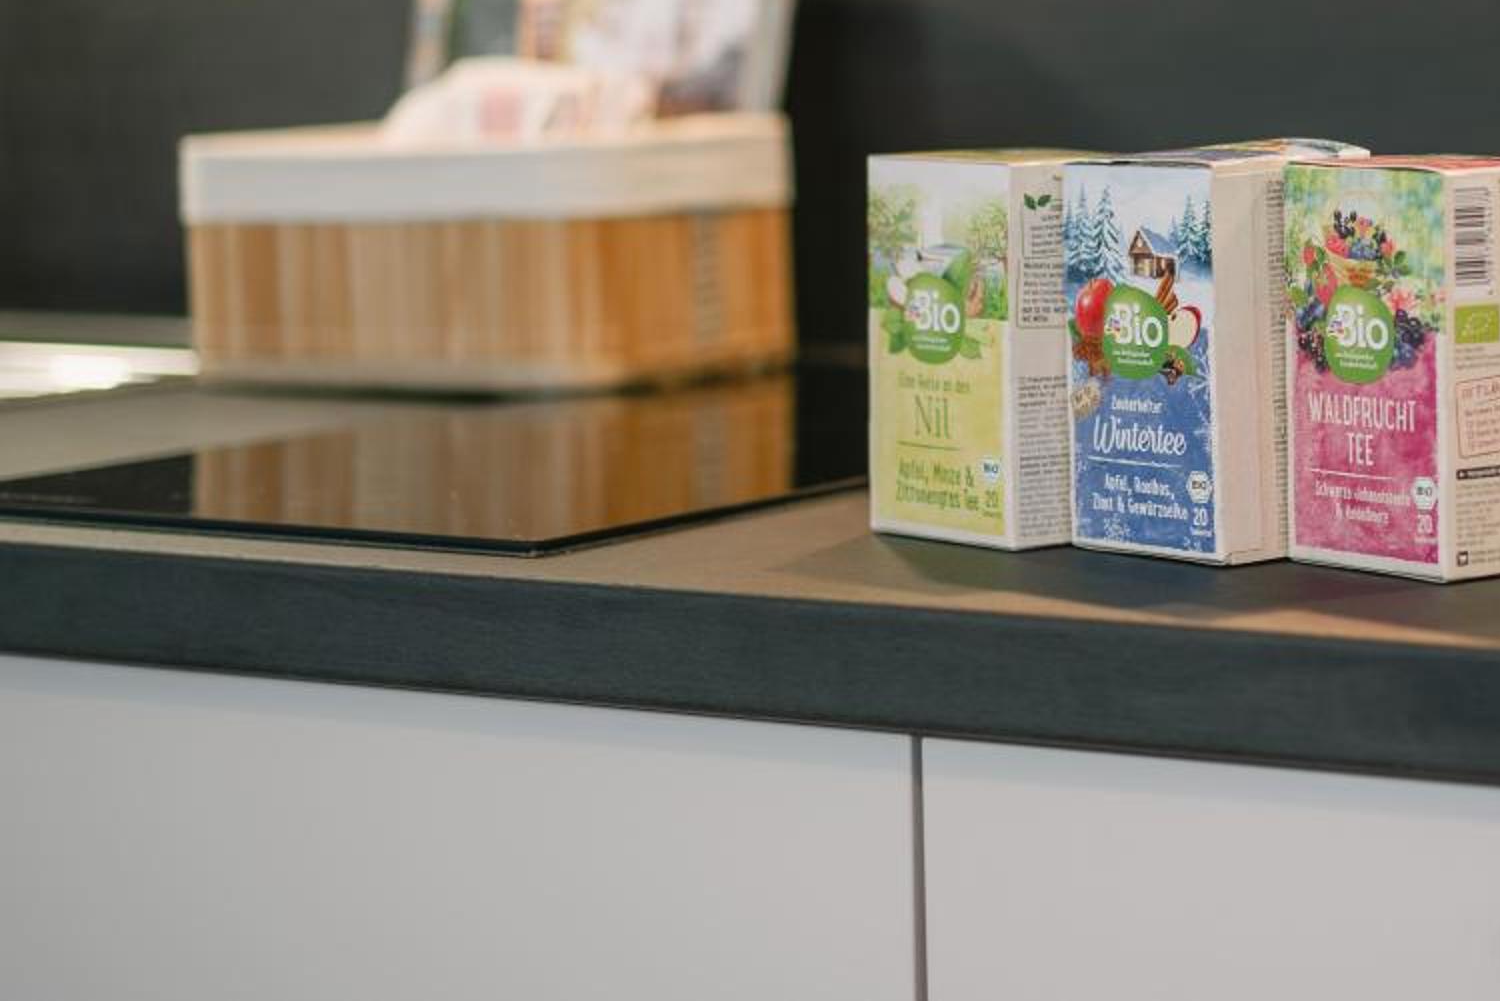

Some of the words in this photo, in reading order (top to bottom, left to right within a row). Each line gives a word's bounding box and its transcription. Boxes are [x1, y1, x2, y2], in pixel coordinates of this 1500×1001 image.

[1113, 303, 1163, 348] Bio
[1336, 304, 1389, 349] Bio
[914, 395, 950, 439] Nil
[1309, 392, 1417, 433] WALDFRUCHT
[1093, 415, 1188, 456] Wintertee
[1347, 432, 1375, 467] TEE
[1193, 507, 1209, 527] 20
[1417, 514, 1433, 535] 20
